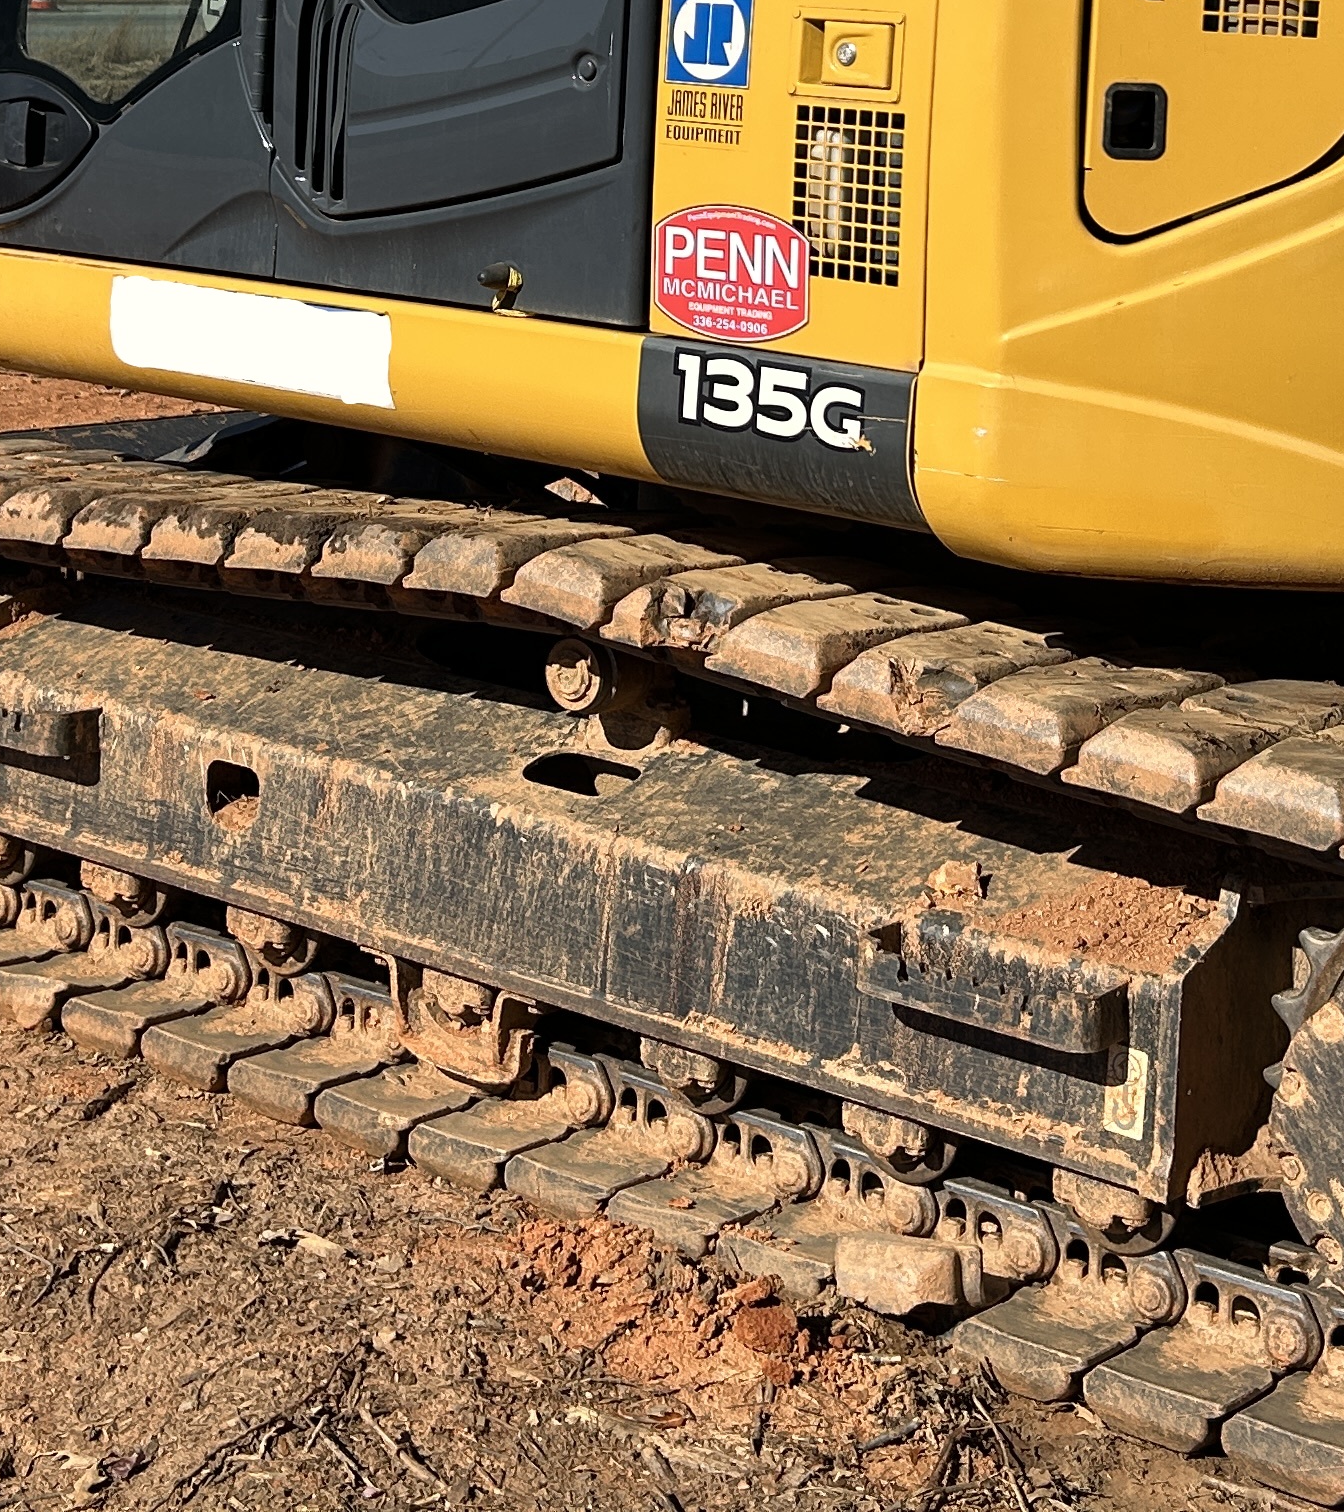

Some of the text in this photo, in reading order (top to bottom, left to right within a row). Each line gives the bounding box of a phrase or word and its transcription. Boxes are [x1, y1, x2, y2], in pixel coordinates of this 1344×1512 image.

[667, 89, 744, 122] JAMES RIVER
[666, 124, 741, 145] EQUIPMENT
[664, 225, 800, 289] PENN
[663, 277, 799, 310] MCMICHAEL
[688, 301, 773, 321] EQUIPMENT TRADING
[693, 315, 768, 335] 336-254-0906
[677, 353, 861, 449] 135G
